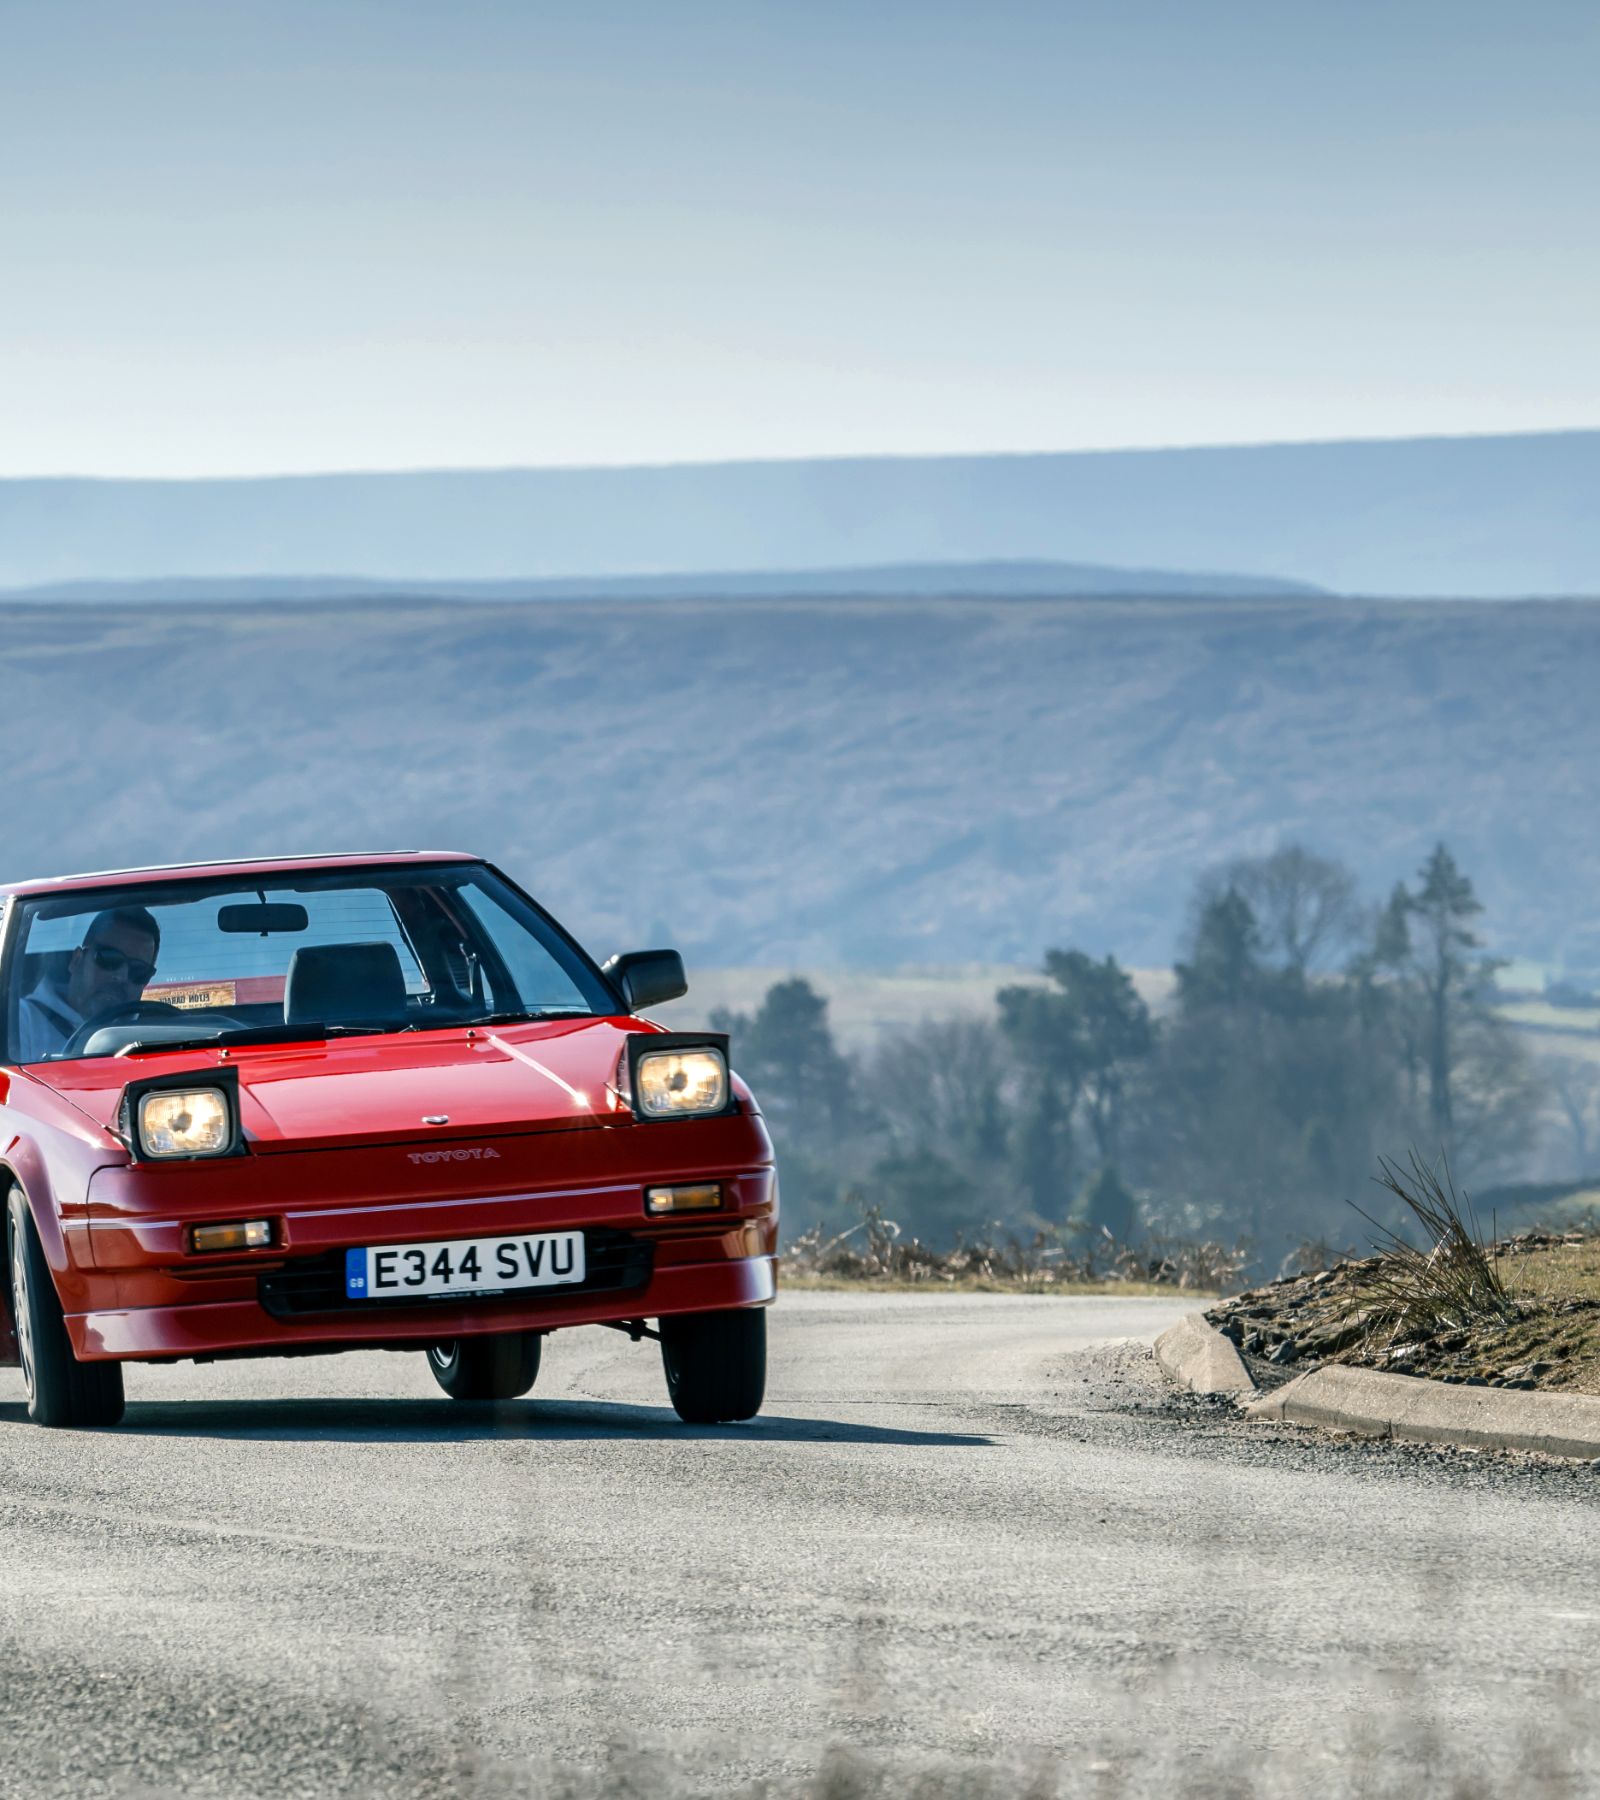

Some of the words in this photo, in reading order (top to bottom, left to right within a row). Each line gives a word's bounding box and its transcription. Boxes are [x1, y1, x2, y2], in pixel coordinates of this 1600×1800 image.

[407, 1147, 501, 1164] TOYOTA
[375, 1246, 482, 1288] E344
[496, 1238, 573, 1280] SVU
[350, 1278, 364, 1288] GB
